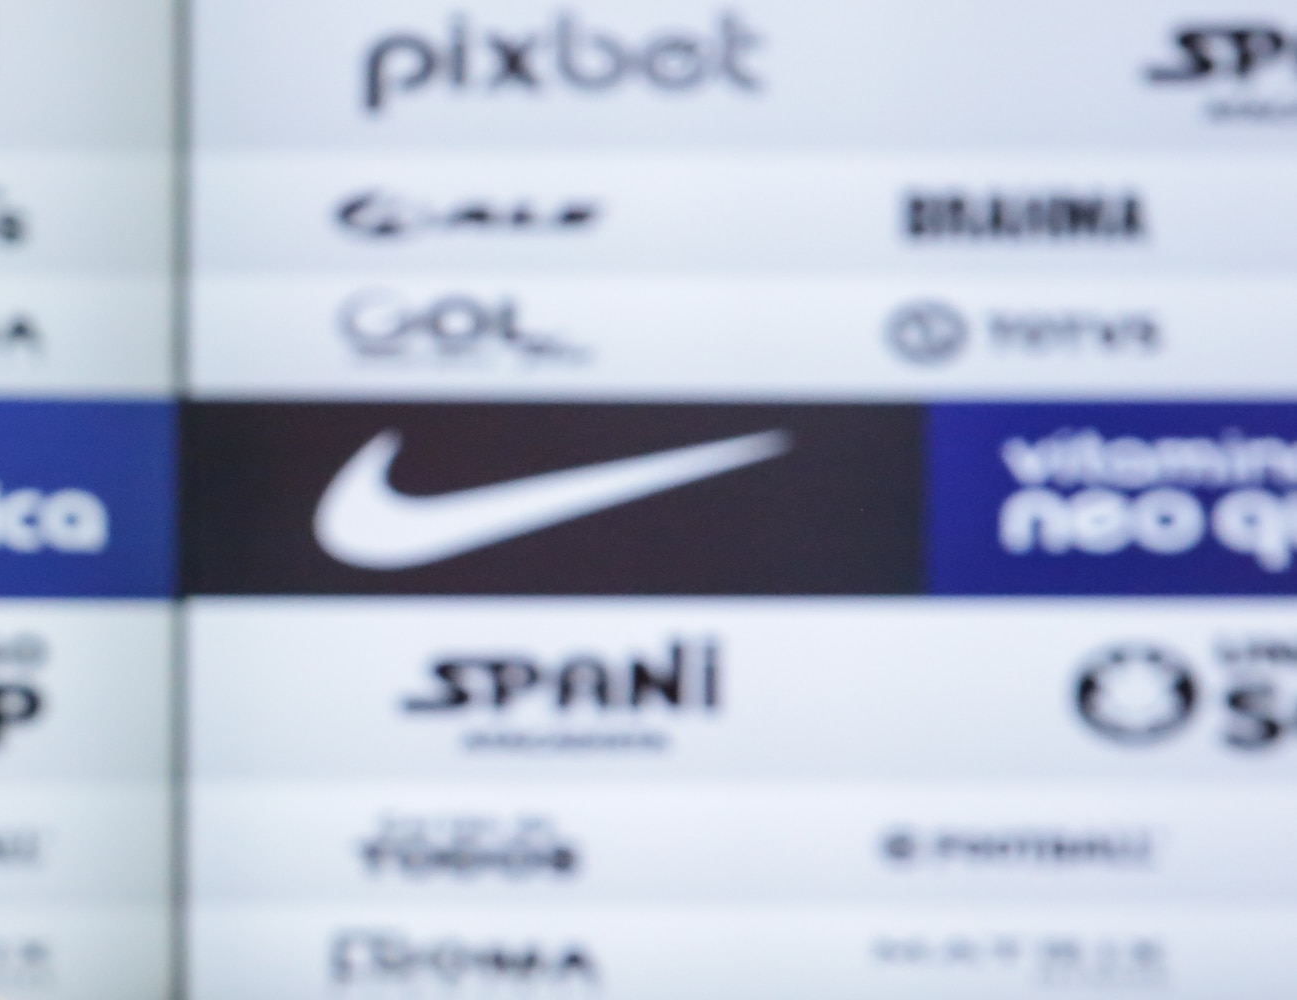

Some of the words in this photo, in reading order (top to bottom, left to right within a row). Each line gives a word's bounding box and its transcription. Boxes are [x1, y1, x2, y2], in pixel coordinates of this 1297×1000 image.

[364, 8, 769, 115] pixbet
[1143, 22, 1297, 84] SP
[399, 636, 722, 715] SPANI
